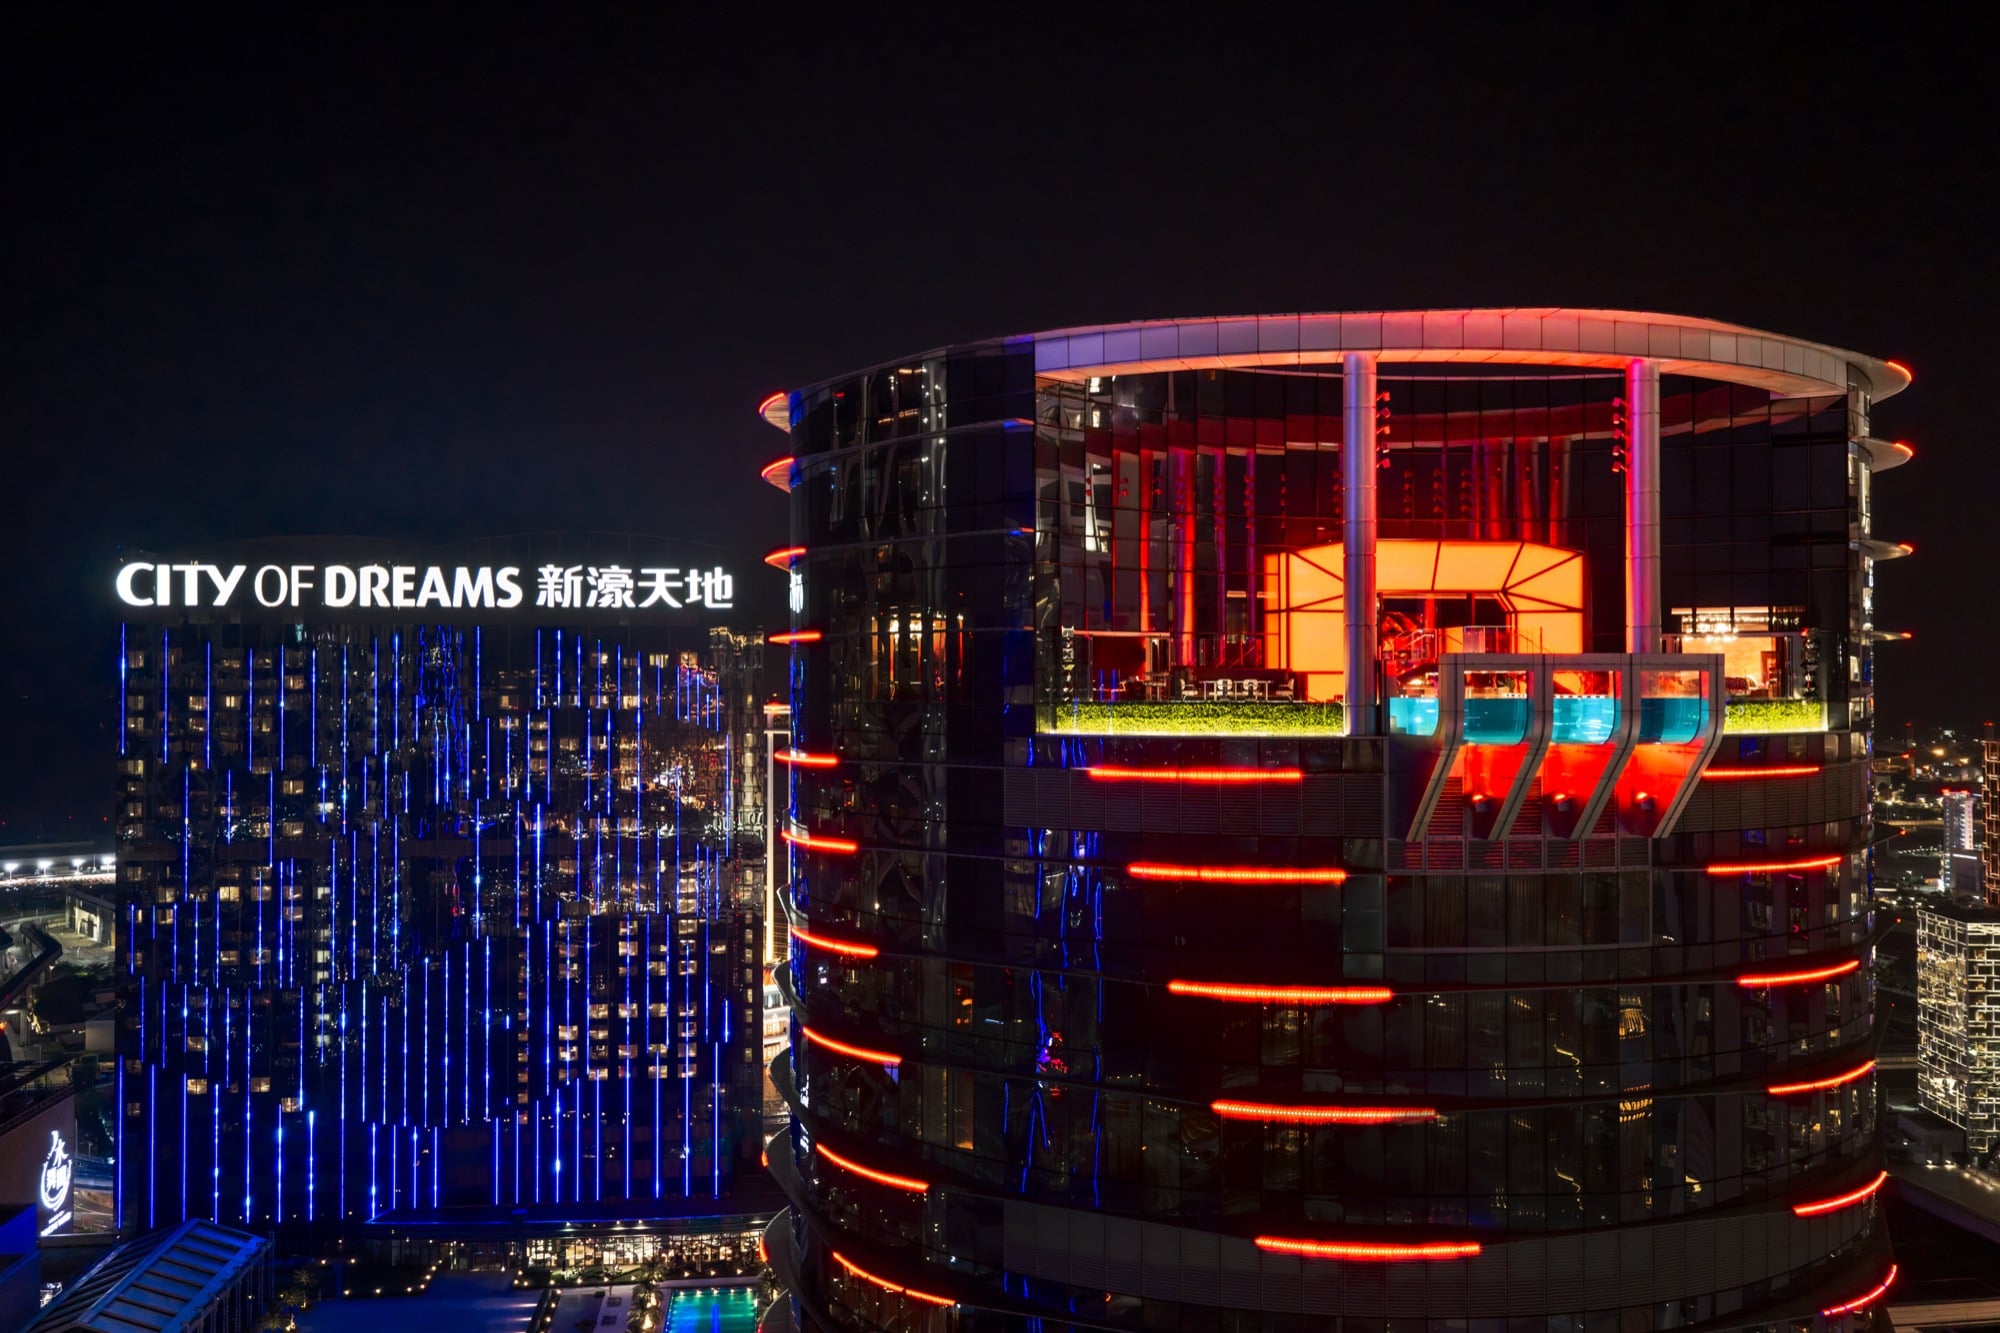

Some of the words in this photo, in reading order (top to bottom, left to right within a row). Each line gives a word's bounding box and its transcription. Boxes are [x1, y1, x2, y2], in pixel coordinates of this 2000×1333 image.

[115, 561, 247, 606] CITY
[254, 564, 315, 606] OF
[324, 563, 523, 607] DREAMS
[535, 563, 733, 608] 新濠天地
